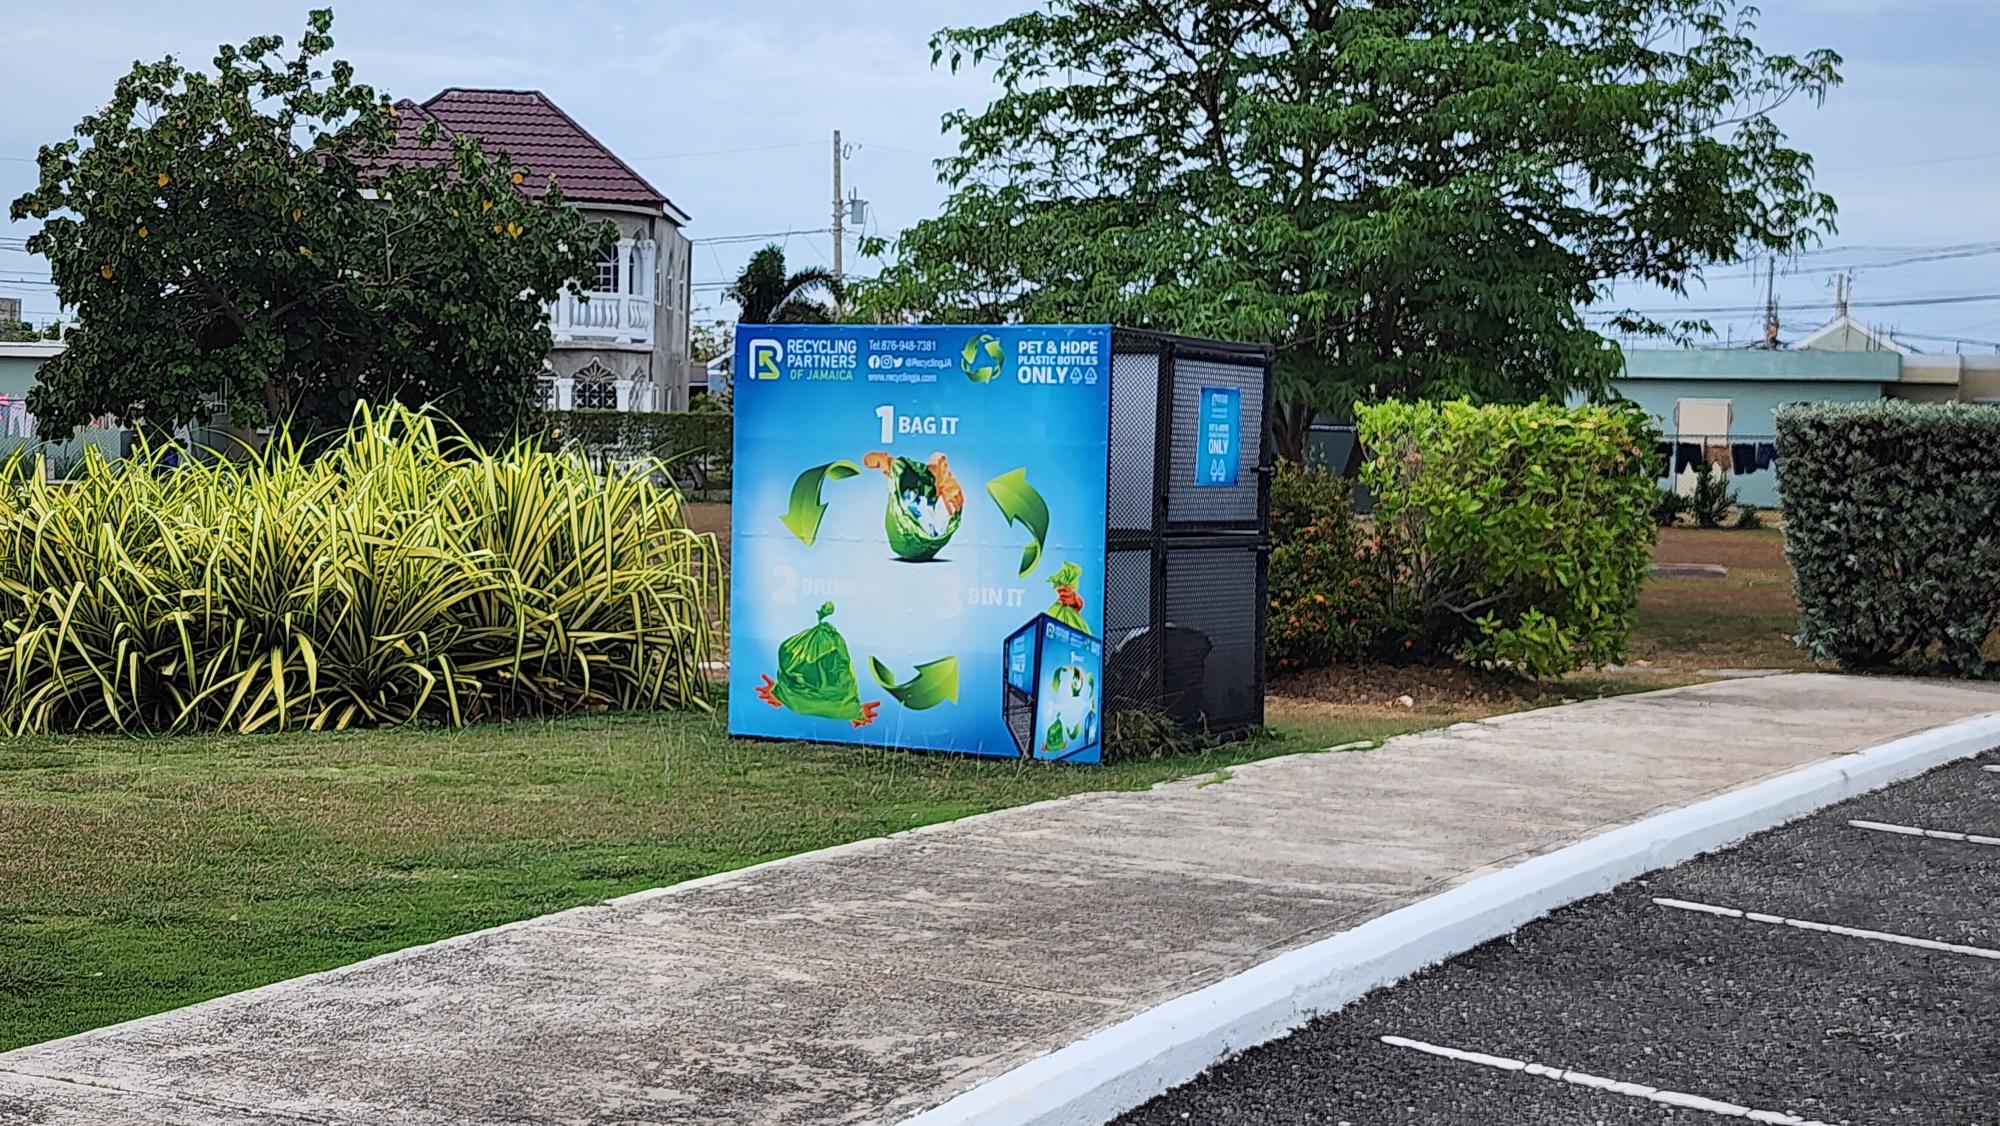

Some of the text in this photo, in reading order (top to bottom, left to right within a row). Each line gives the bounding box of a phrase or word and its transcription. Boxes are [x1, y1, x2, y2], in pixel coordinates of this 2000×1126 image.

[787, 339, 857, 354] RECYCLING
[1018, 340, 1099, 354] PET & HDPE
[787, 355, 857, 368] PARTNERS
[1018, 355, 1098, 366] PLASTIC BOTTLES
[790, 369, 854, 381] OF JAMAICA
[1017, 366, 1069, 384] ONLY
[875, 405, 960, 444] 1 BAG IT
[1208, 438, 1229, 455] ONLY
[771, 565, 798, 603] 2
[935, 573, 1026, 619] 3 BIN IT
